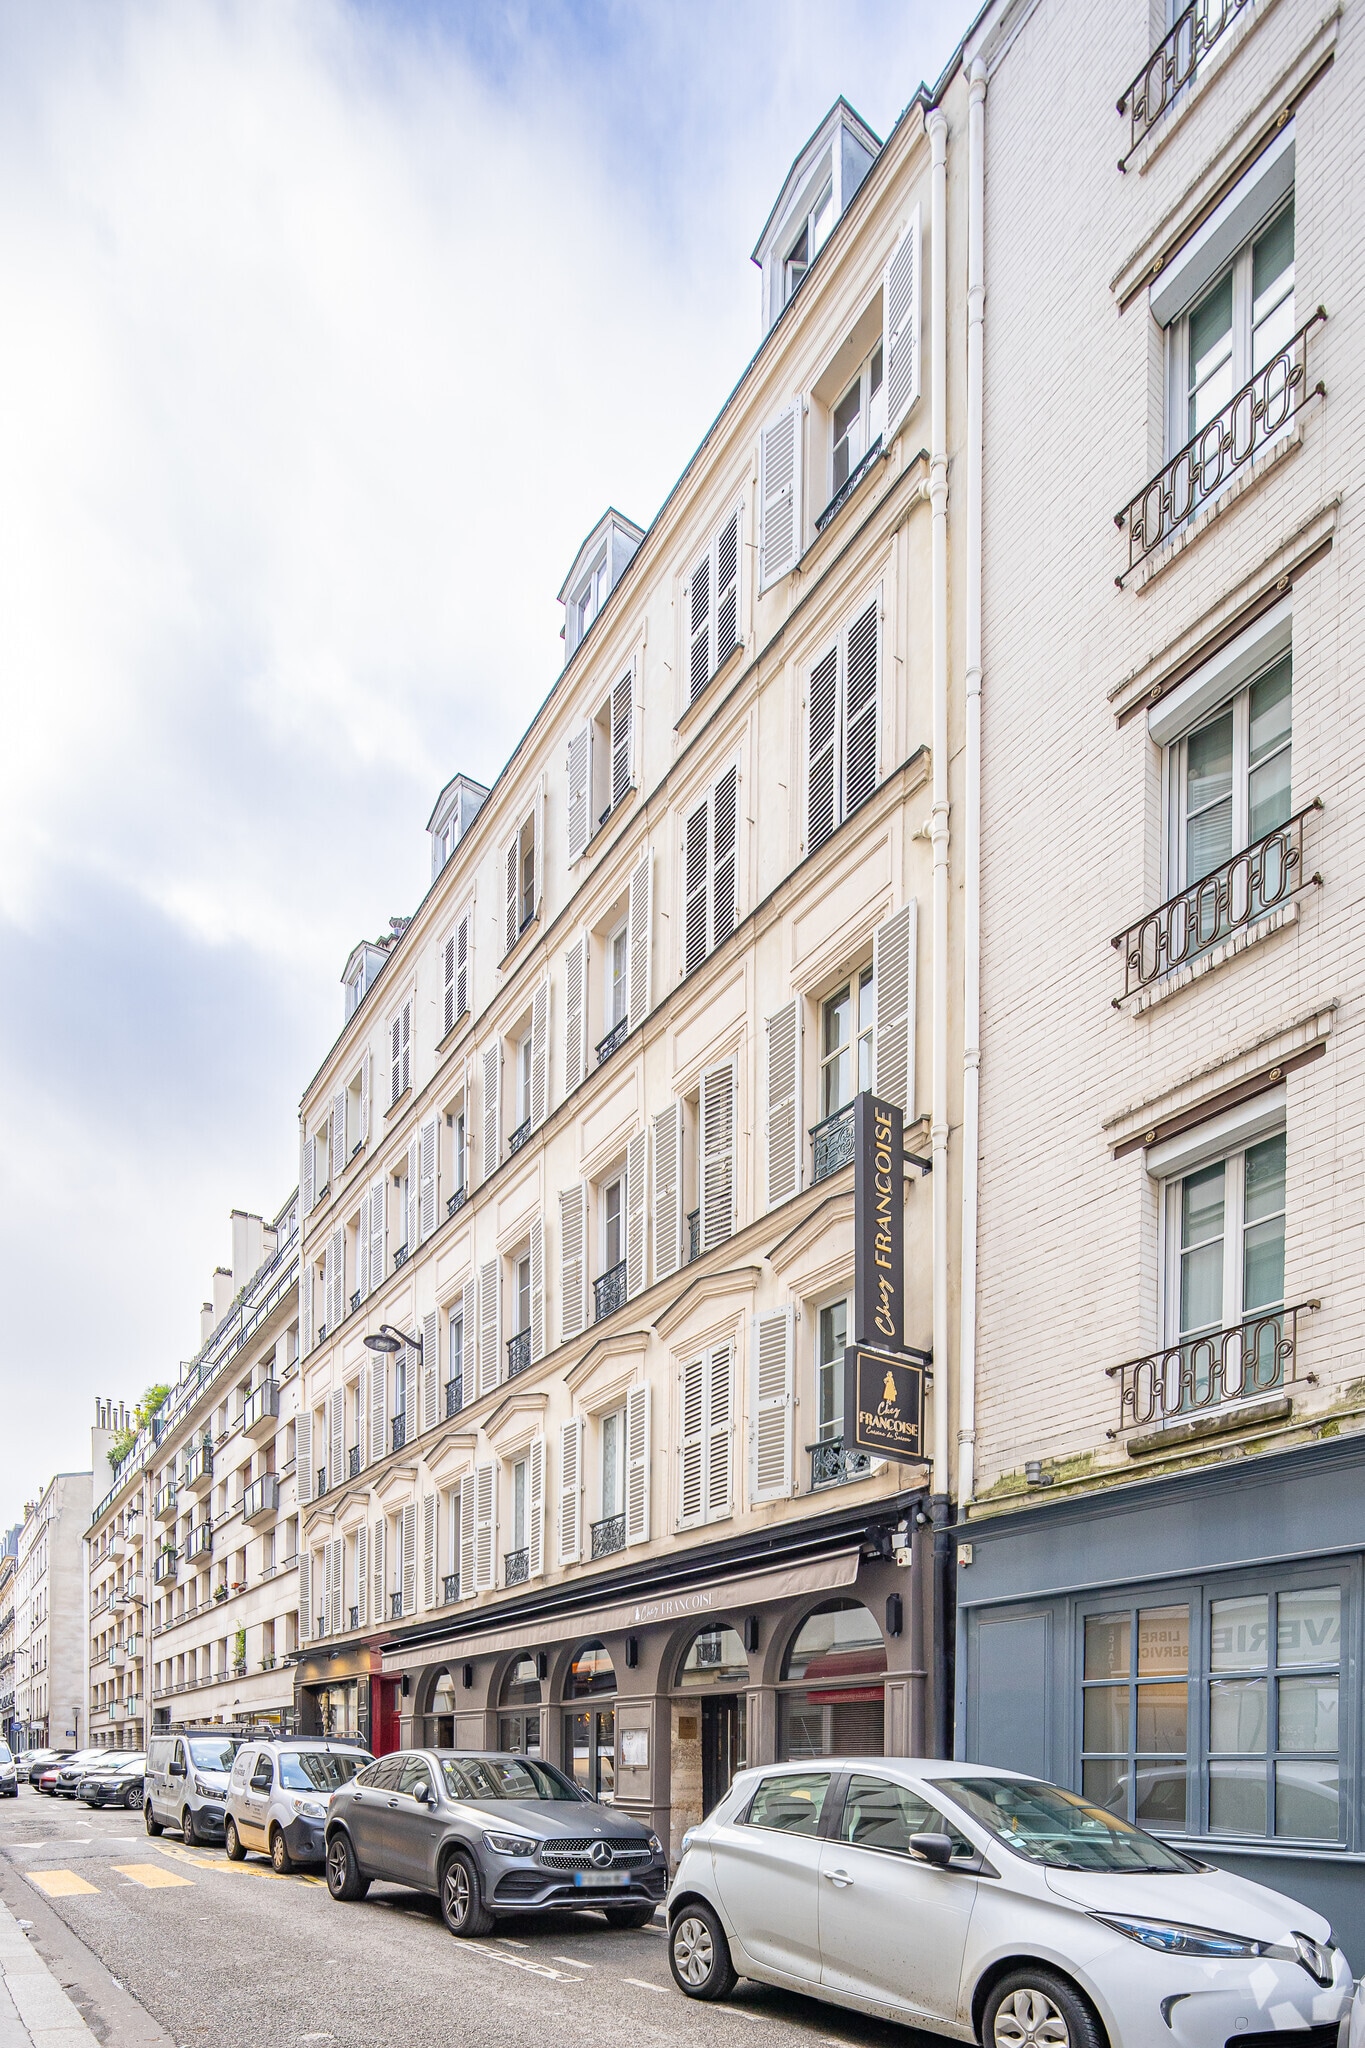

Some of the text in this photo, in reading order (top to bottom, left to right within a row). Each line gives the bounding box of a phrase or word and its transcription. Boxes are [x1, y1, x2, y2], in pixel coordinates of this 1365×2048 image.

[874, 1274, 896, 1337] Chez
[877, 1400, 901, 1419] Chez
[640, 1605, 659, 1621] Chez
